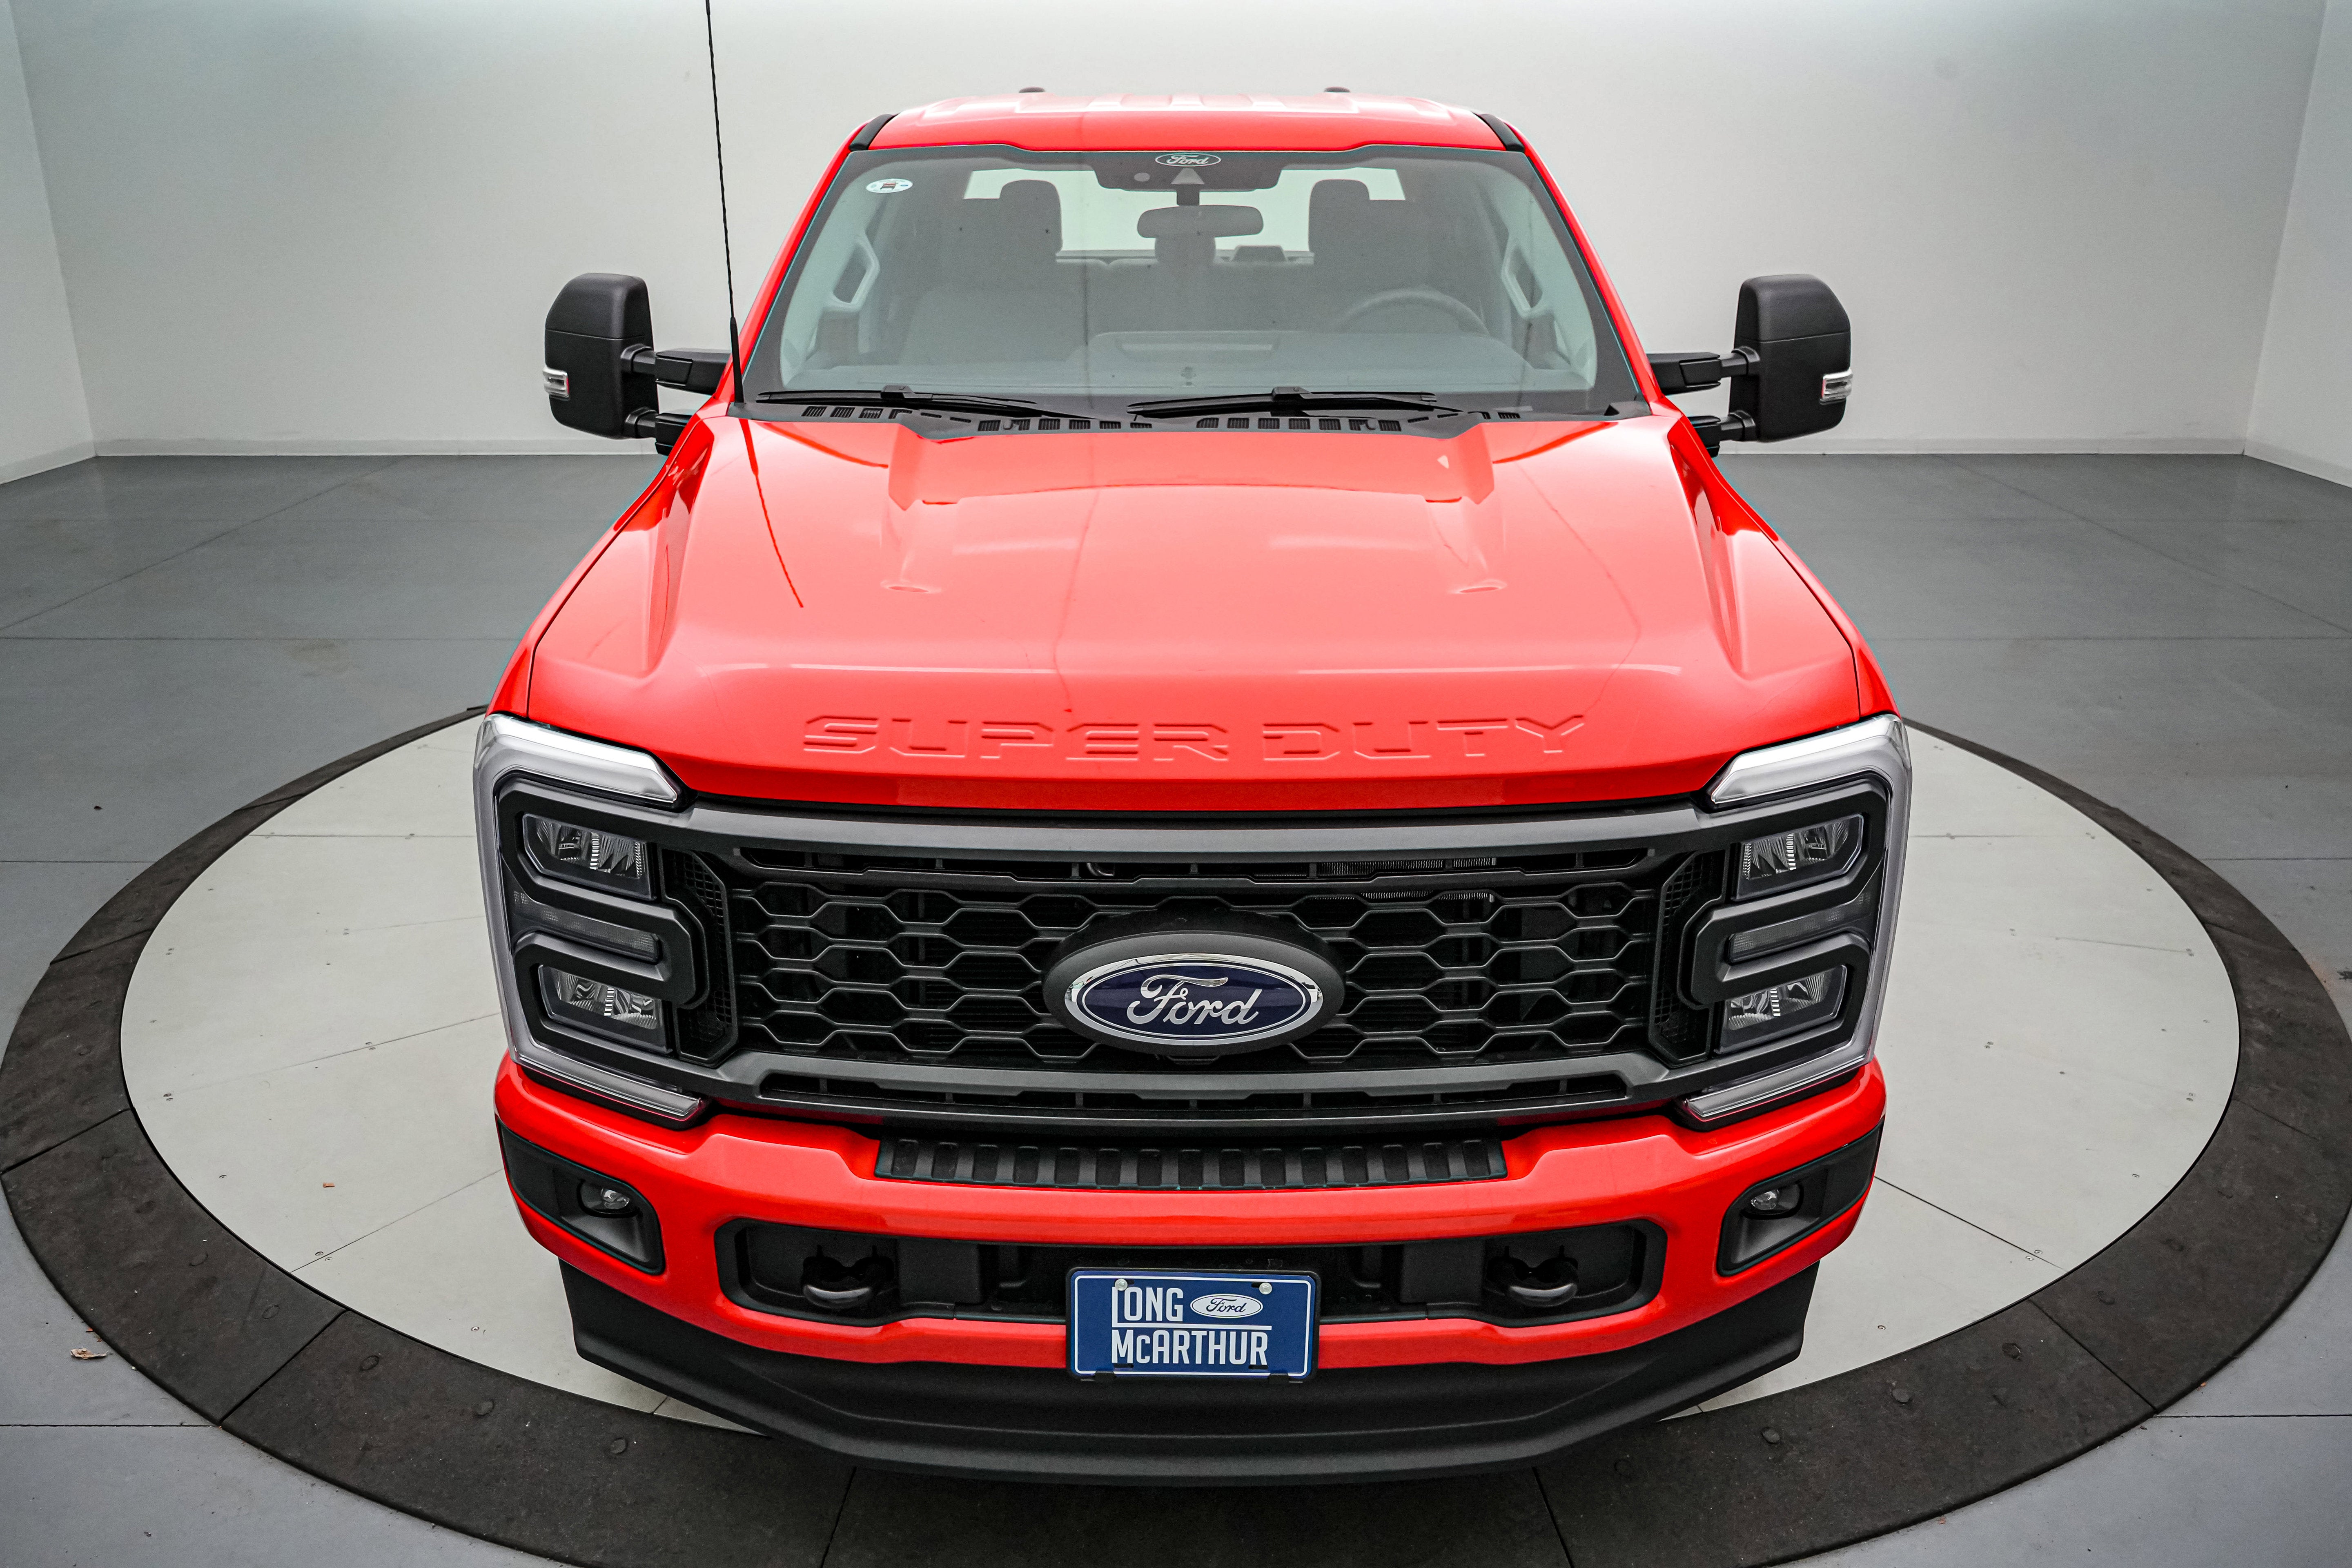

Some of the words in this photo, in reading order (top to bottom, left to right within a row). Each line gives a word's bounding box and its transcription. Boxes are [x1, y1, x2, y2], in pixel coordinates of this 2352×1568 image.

[1167, 154, 1209, 165] Ford
[803, 715, 1228, 761] SUPER
[1263, 715, 1584, 760] DUTY
[1127, 974, 1263, 1025] Ford
[1112, 1286, 1183, 1327] LONG
[1206, 1297, 1247, 1313] Ford
